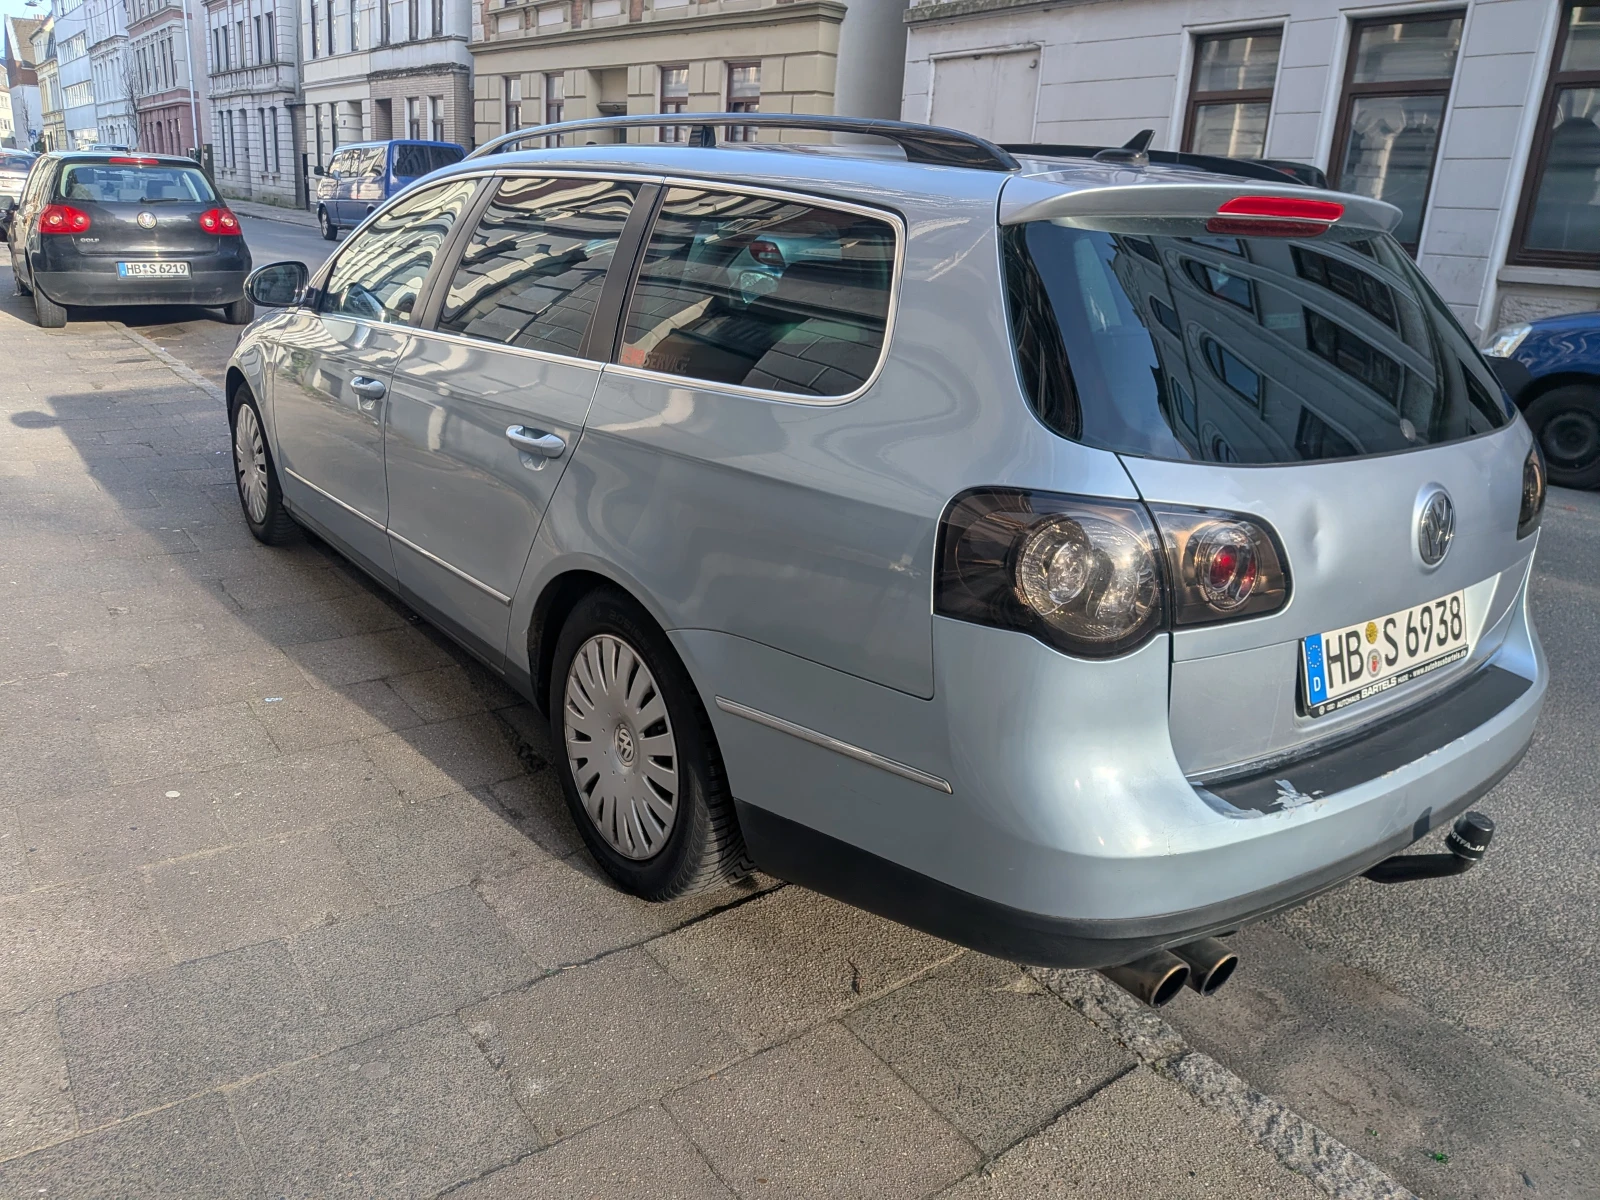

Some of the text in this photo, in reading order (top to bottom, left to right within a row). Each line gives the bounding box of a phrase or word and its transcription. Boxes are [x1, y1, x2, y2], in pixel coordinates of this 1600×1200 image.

[126, 263, 142, 275] HB
[149, 263, 157, 274] S
[159, 263, 187, 274] 6219
[1313, 595, 1463, 693] D HB S 6938
[1361, 676, 1398, 699] BARTELS
